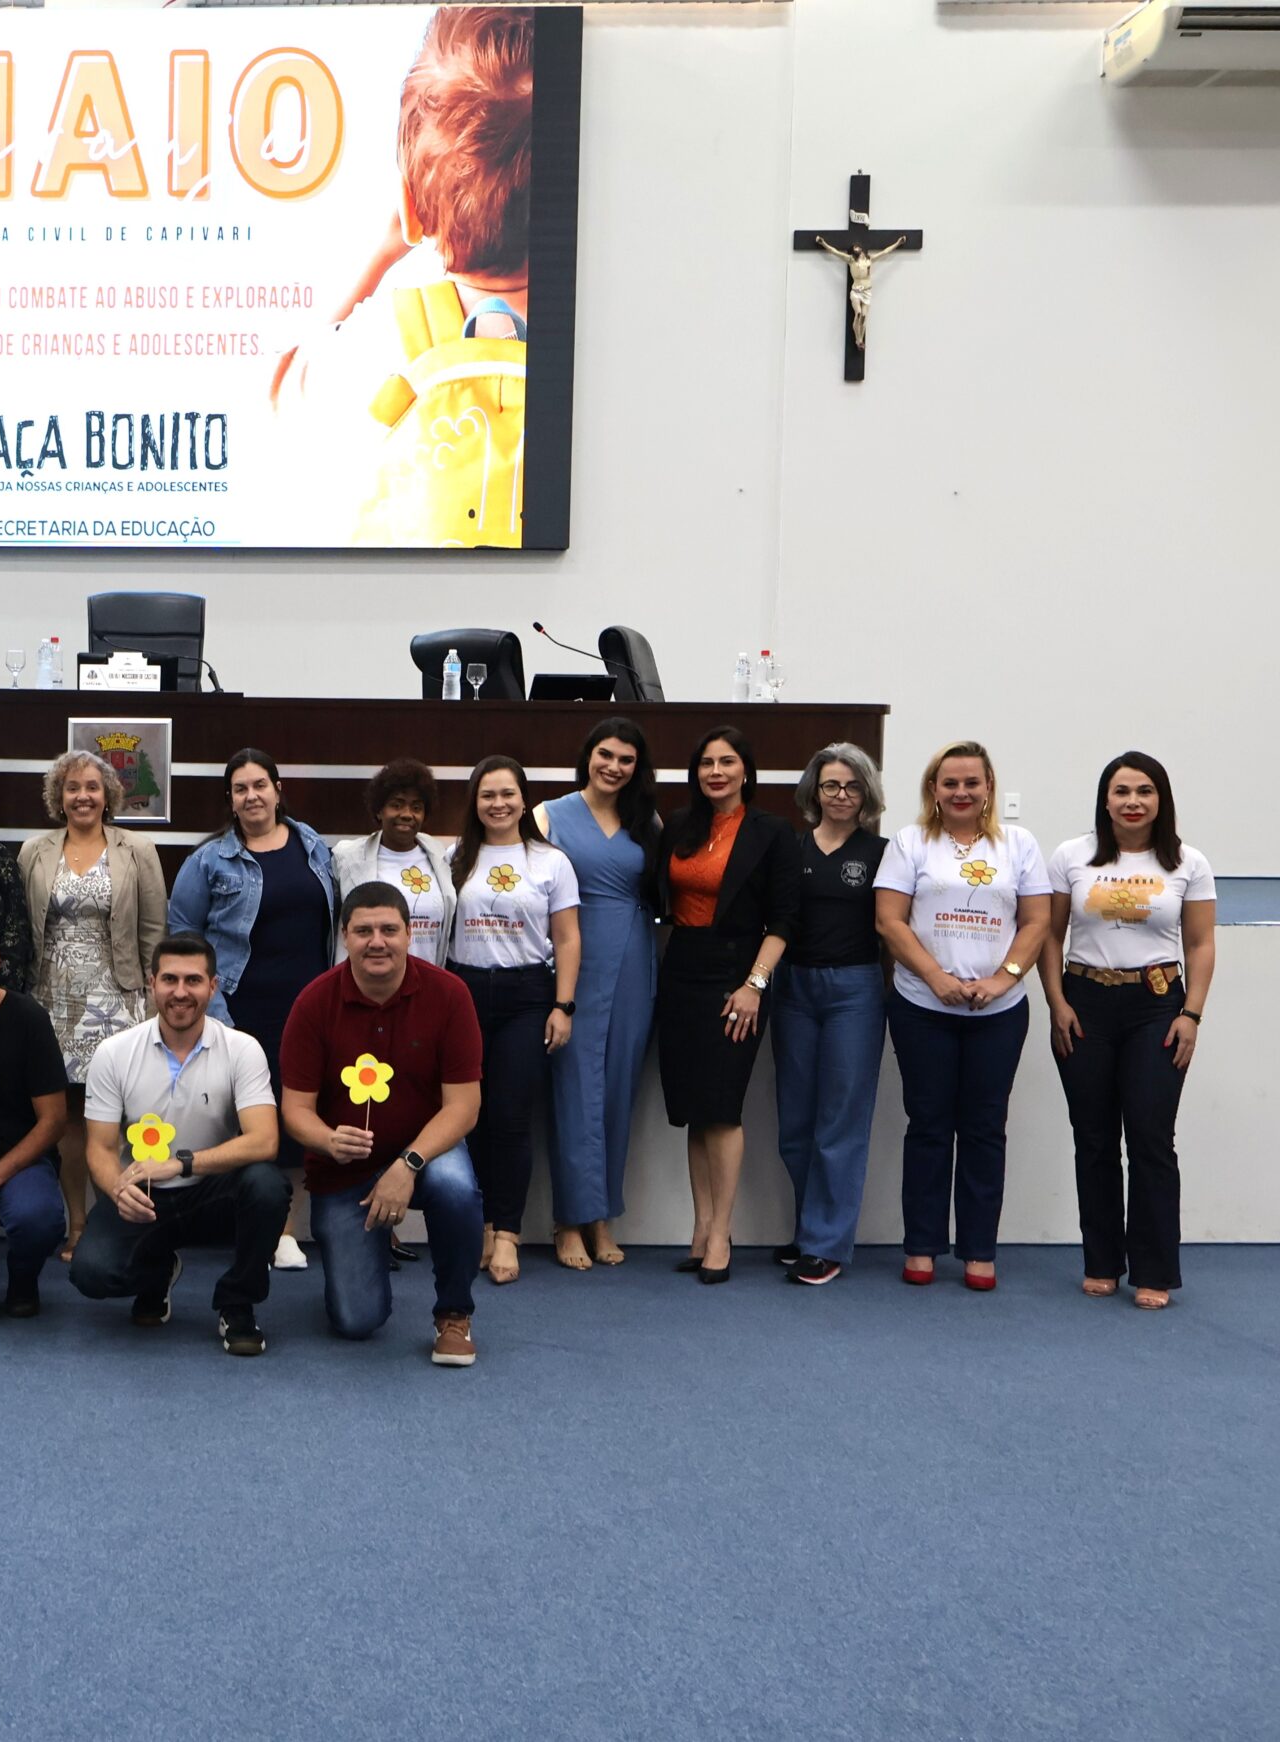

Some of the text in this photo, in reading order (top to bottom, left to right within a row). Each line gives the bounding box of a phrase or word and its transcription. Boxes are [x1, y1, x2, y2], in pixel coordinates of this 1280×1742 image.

[27, 226, 86, 242] CIVIL
[106, 226, 127, 242] DE
[146, 226, 251, 242] CAPIVARI
[9, 286, 87, 309] COMBATE
[96, 286, 115, 309] AO
[124, 286, 177, 309] ABUSO
[187, 286, 194, 309] E
[203, 282, 313, 311] EXPLORAÇÃO
[22, 334, 105, 359] CRIANÇAS
[114, 334, 121, 356] E
[129, 334, 264, 356] ADOLESCENTES.
[86, 411, 228, 471] BONITO
[17, 481, 62, 492] NOSSAS
[65, 481, 123, 494] CRIANÇAS
[128, 482, 134, 492] E
[137, 481, 228, 492] ADOLESCENTES
[93, 520, 116, 536] DA
[121, 517, 216, 542] EDUCAÇÃO
[464, 919, 524, 929] COMBATE AO
[935, 912, 1002, 926] COMBATE AO
